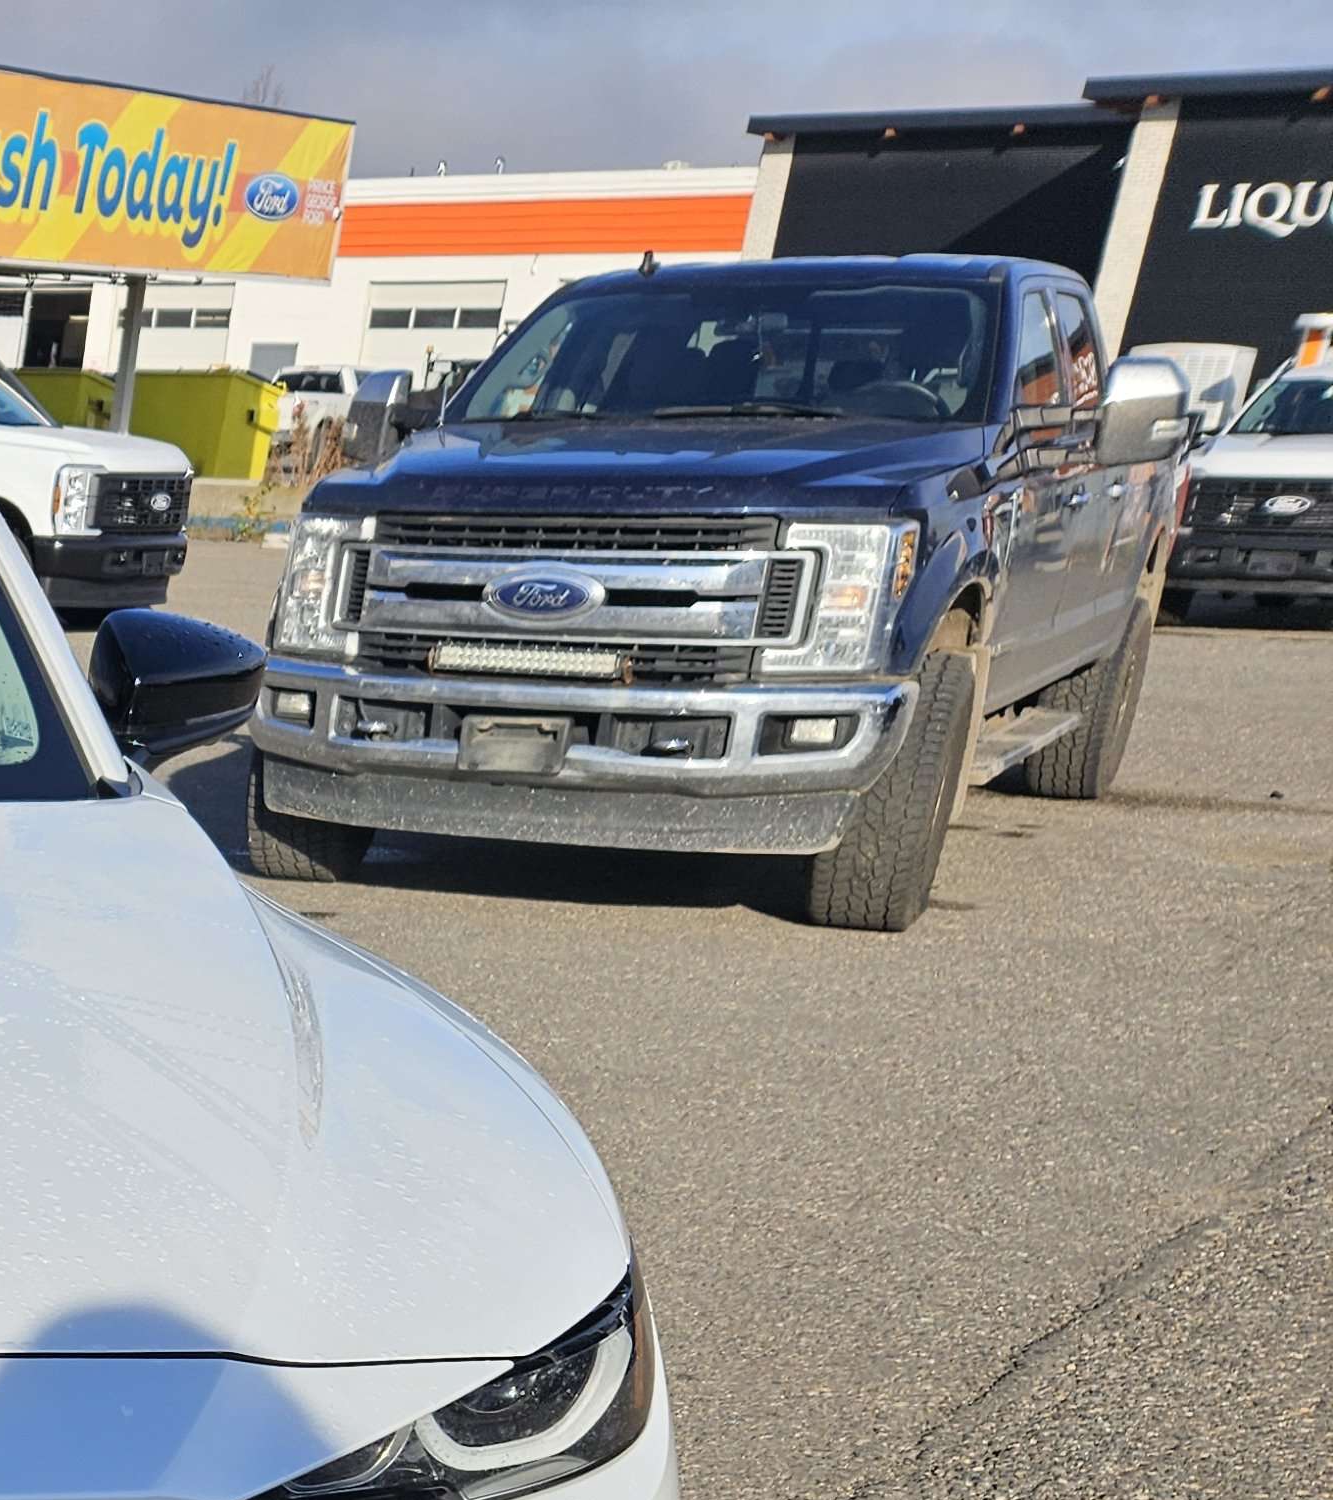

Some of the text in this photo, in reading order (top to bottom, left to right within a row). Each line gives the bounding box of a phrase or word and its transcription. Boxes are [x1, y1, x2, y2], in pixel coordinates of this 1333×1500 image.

[73, 121, 238, 249] Today!
[253, 178, 291, 214] Ford
[1188, 180, 1333, 239] LIQU
[512, 582, 571, 608] Ford
